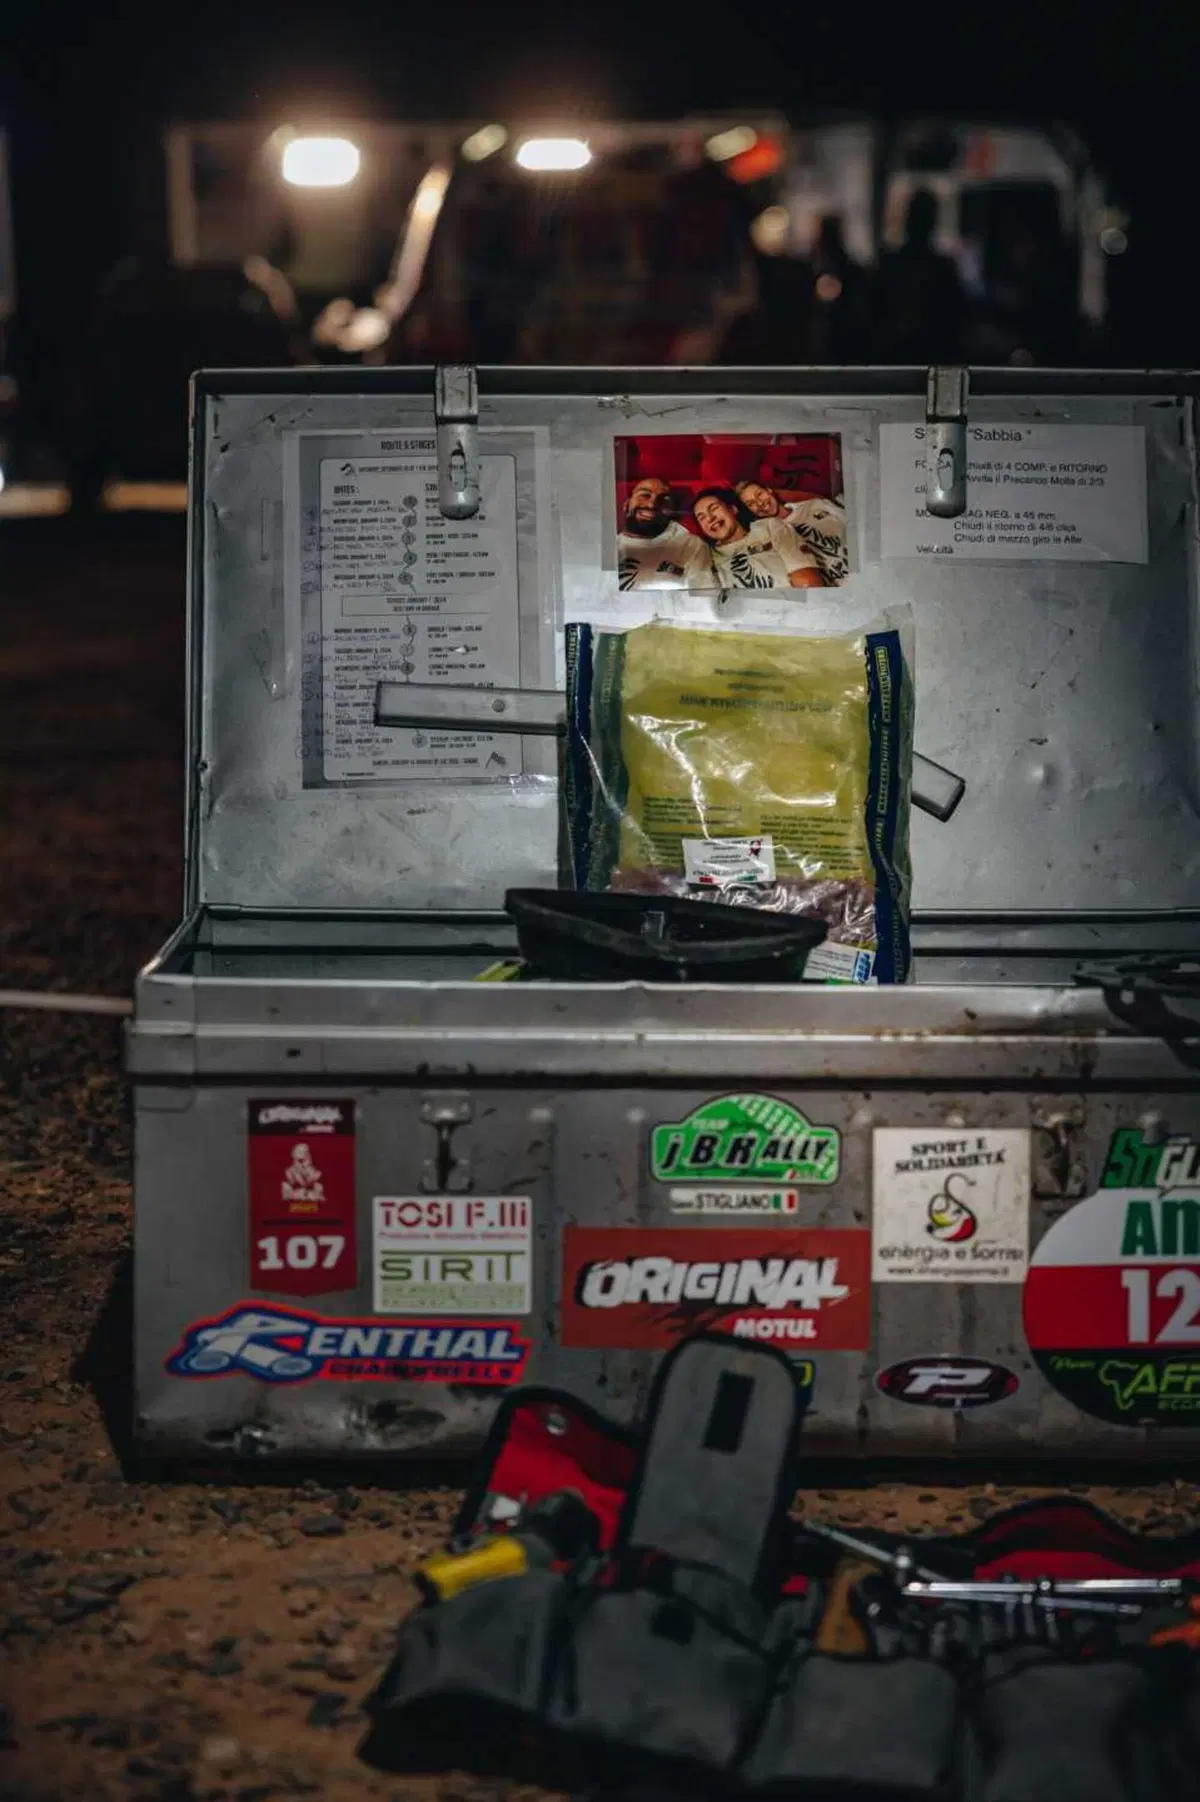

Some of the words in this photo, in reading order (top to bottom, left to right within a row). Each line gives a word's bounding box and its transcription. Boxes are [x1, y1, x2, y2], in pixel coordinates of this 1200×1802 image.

[1058, 463, 1108, 473] RITORNO
[954, 521, 984, 531] Chiudi
[1027, 522, 1037, 531] di
[954, 533, 984, 543] Chiudi
[987, 533, 996, 543] di
[911, 1139, 968, 1157] SPORT
[976, 1136, 987, 1150] E
[696, 1192, 771, 1210] STIGLIANO
[380, 1201, 454, 1228] TOSI
[256, 1234, 346, 1271] 107
[380, 1251, 525, 1281] SIRIT
[734, 1318, 818, 1340] MOTUL
